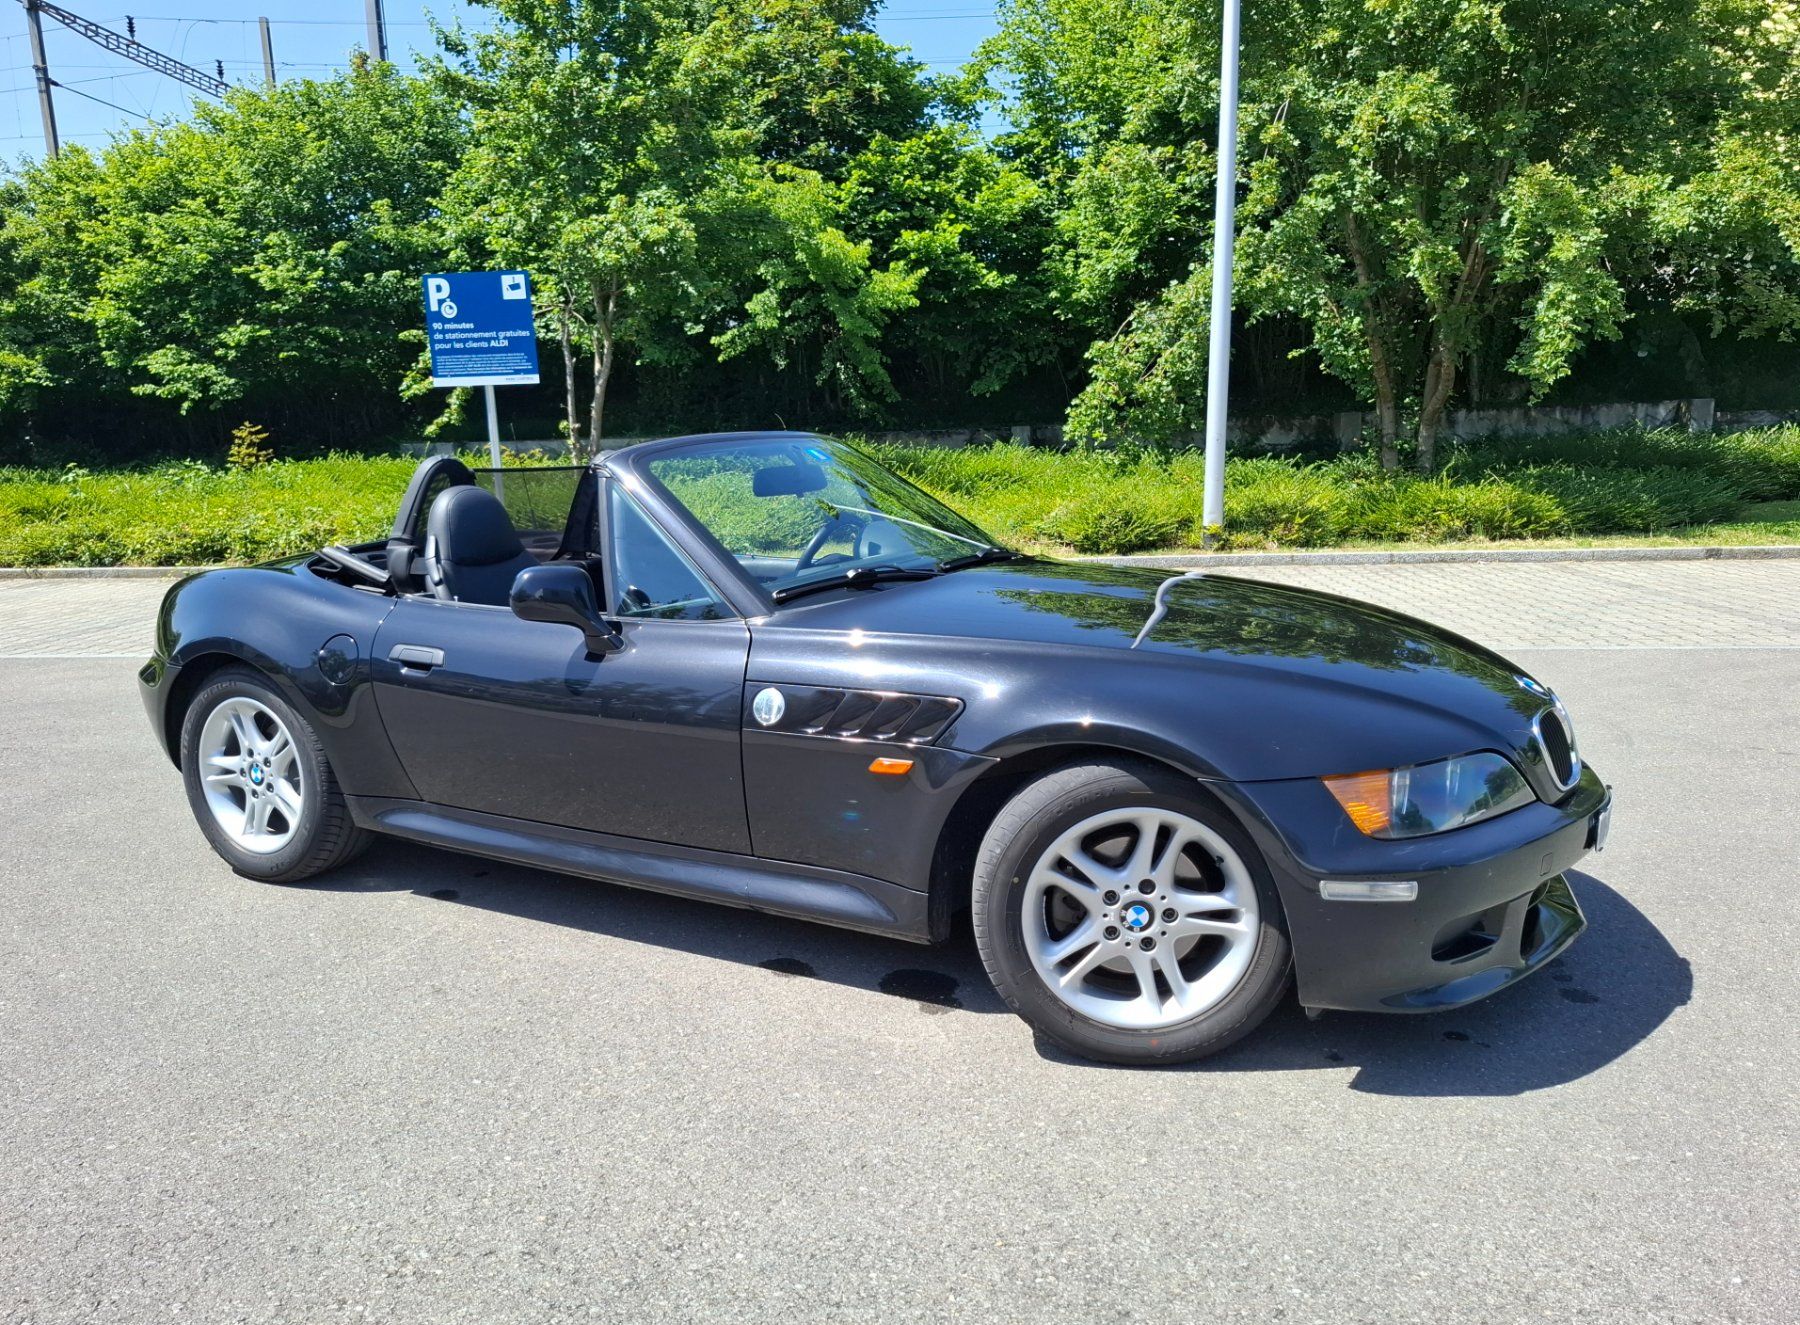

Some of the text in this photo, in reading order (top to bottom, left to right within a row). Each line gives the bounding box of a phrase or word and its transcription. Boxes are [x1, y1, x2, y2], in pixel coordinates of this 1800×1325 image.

[428, 277, 450, 311] P
[445, 331, 497, 340] stationnement
[498, 329, 530, 339] gratuites
[490, 339, 509, 347] ALDI
